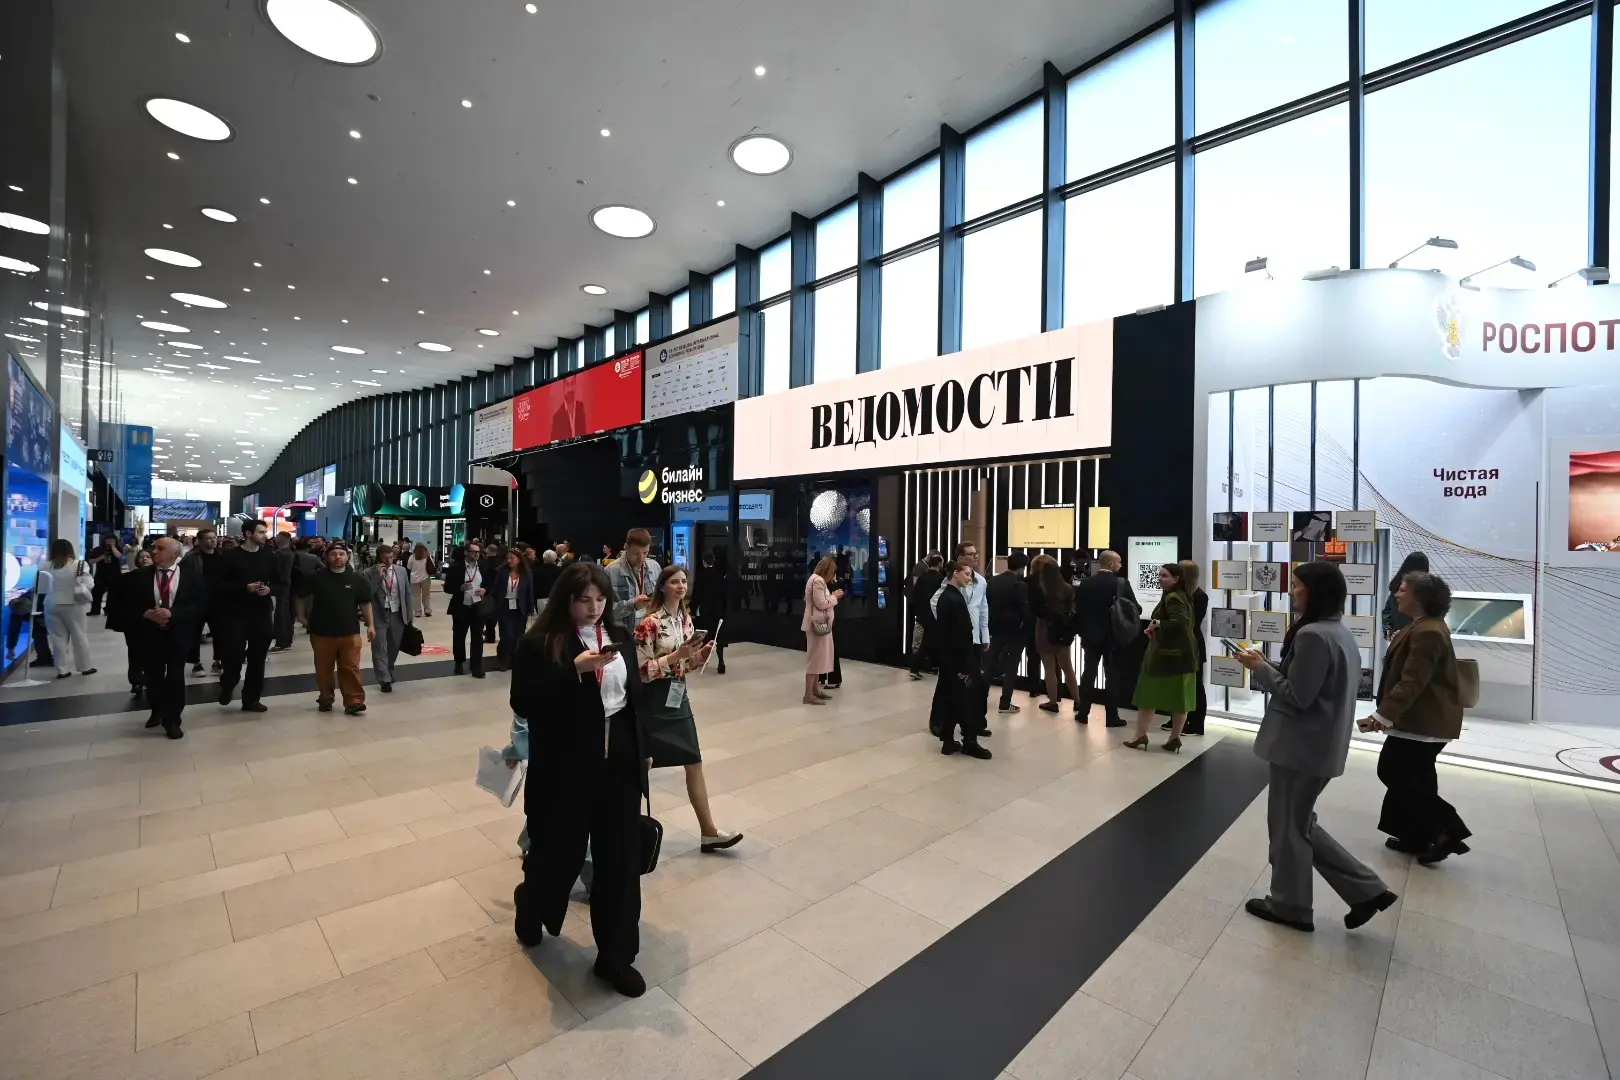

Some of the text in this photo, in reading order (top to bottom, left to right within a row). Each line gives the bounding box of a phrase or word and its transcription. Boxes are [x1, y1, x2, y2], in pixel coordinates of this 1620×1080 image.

[1482, 318, 1620, 354] РОСПОТ
[810, 357, 1075, 451] ВЕДОМОСТИ
[661, 464, 703, 484] билайн
[1433, 467, 1499, 482] Чистая
[661, 487, 703, 504] бизнес
[1443, 485, 1487, 499] вода
